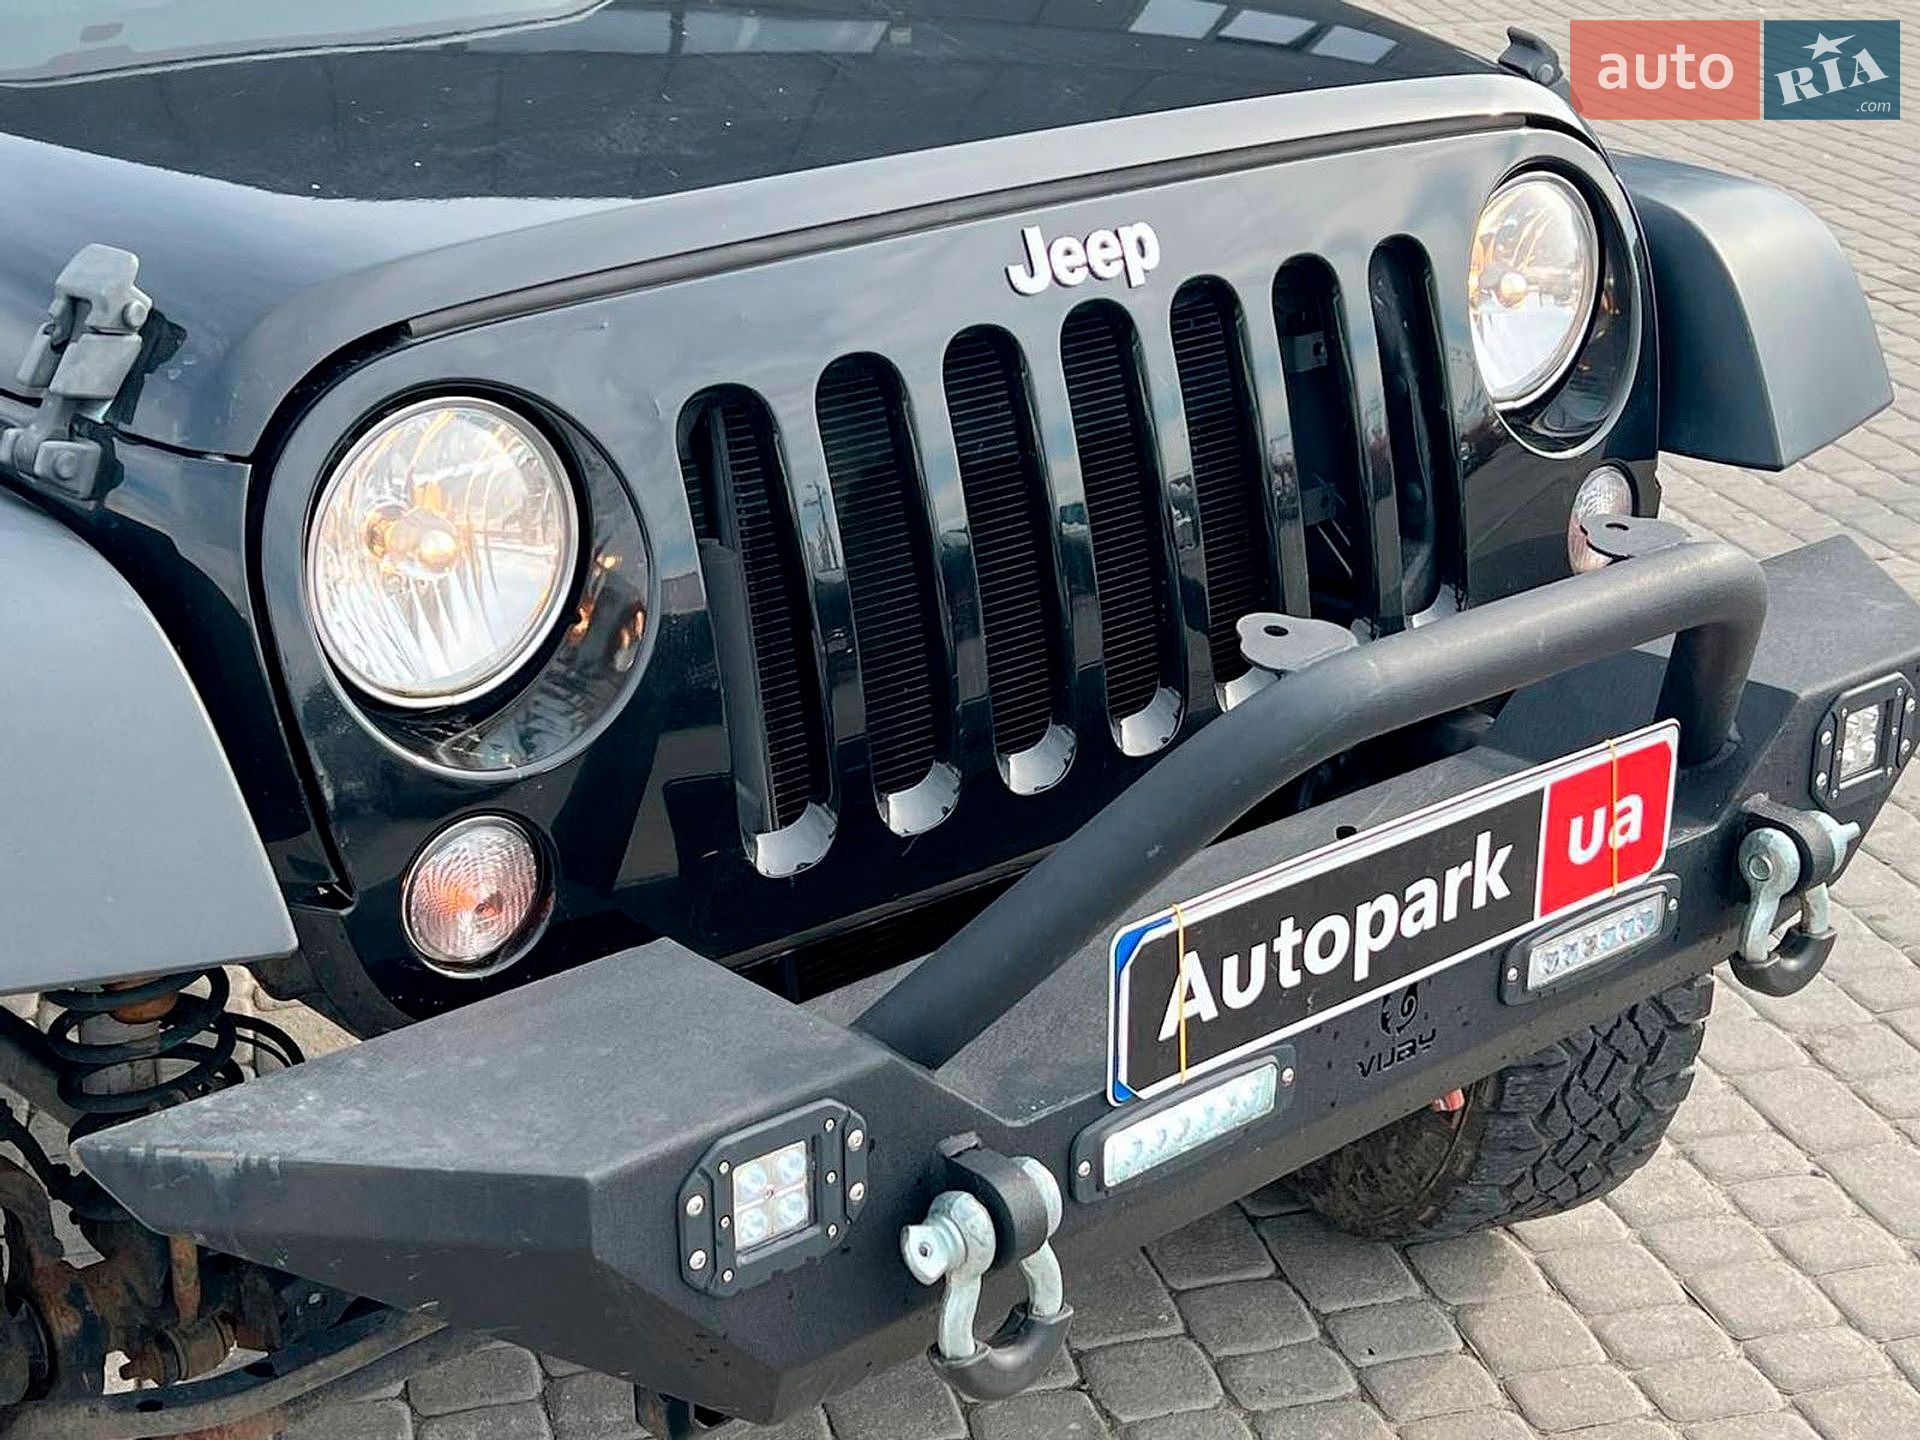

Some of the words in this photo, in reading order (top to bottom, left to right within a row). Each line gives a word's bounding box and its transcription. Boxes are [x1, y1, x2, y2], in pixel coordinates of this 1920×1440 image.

[1004, 221, 1161, 297] Jeep
[1157, 830, 1514, 1042] Autopark
[1567, 791, 1644, 866] ua
